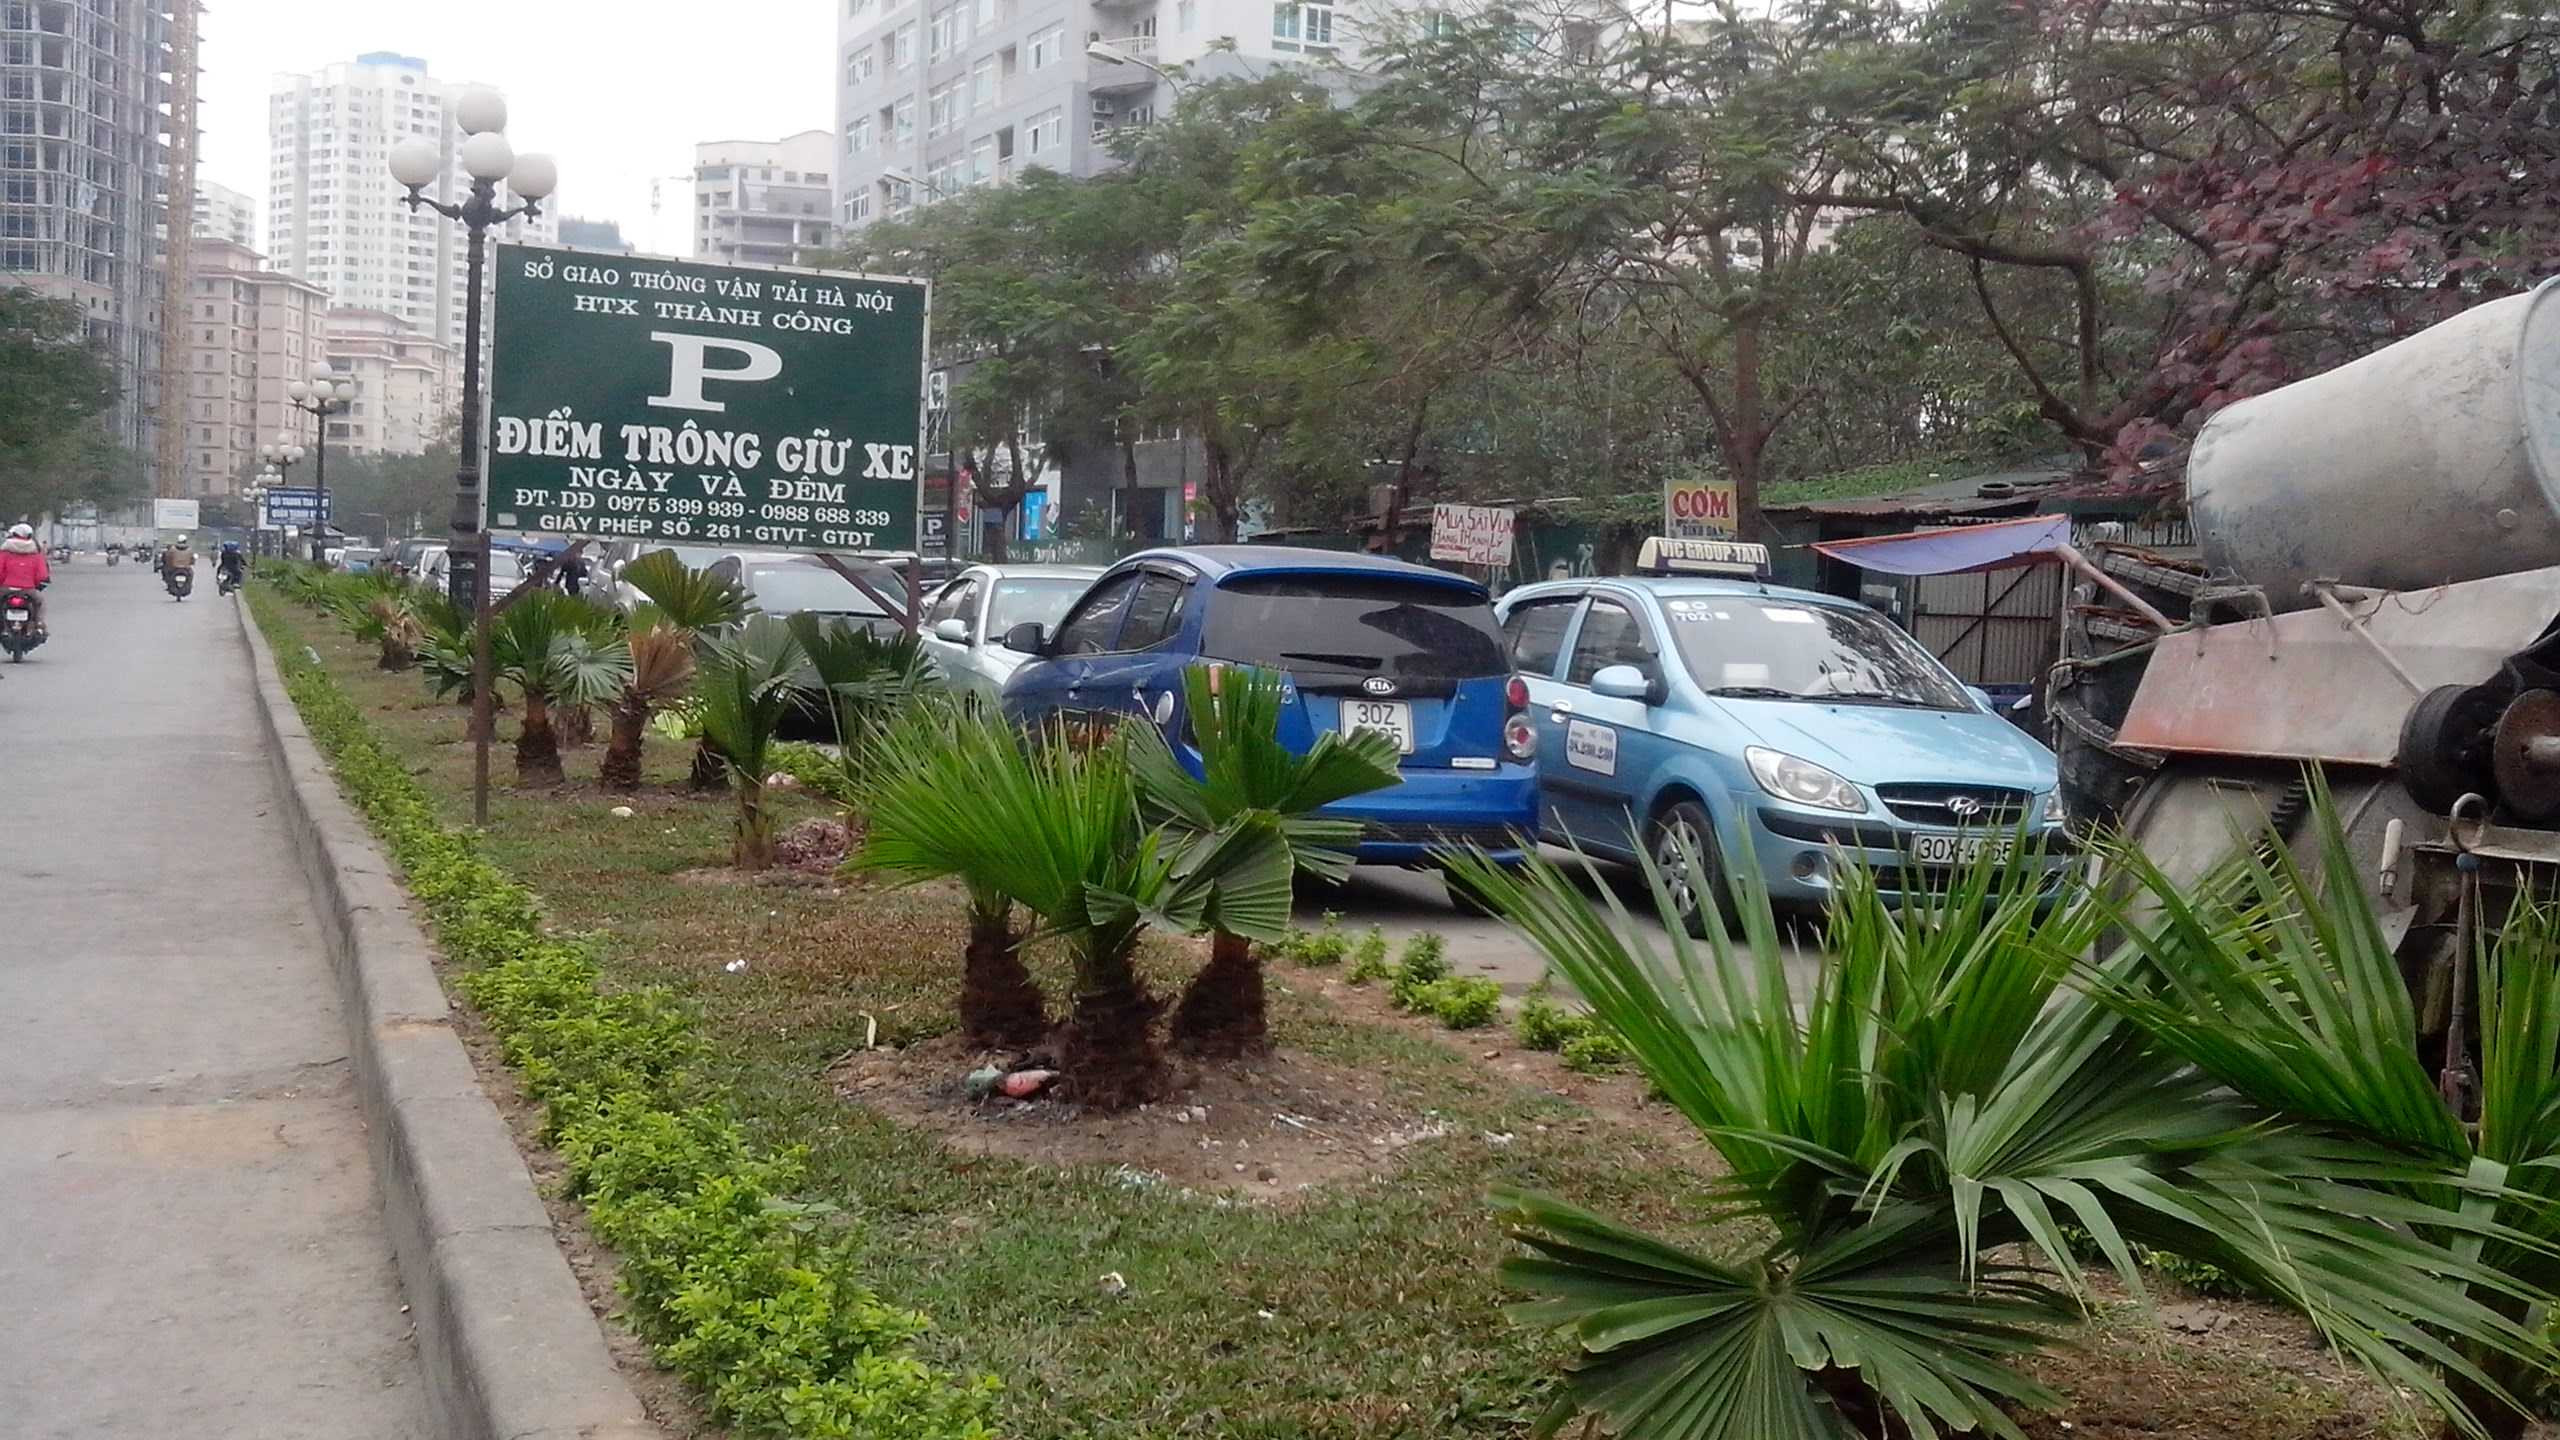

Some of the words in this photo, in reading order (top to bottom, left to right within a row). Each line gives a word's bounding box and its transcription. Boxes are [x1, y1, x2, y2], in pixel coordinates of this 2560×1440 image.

[524, 255, 554, 279] SỞ
[563, 265, 620, 285] GIAO
[630, 270, 706, 293] THÔNG
[715, 276, 761, 300] VẬN
[772, 279, 808, 303] TẢI
[816, 286, 846, 307] HÀ
[856, 290, 894, 314] NỘI
[574, 295, 640, 315] HTX
[654, 301, 762, 327] THÀNH
[772, 310, 854, 335] CÔNG
[647, 330, 783, 413] P
[496, 406, 602, 459] ĐIỂM
[620, 418, 762, 470] TRÔNG
[776, 428, 853, 476] GIỮ
[862, 443, 914, 481] XE
[569, 464, 674, 492] NGÀY
[698, 470, 746, 497] VÀ
[769, 476, 846, 503] ĐÊM
[539, 511, 593, 532] GIẤY
[600, 514, 653, 535] PHÉP
[706, 523, 741, 539] 261
[607, 495, 661, 514] 0975
[665, 499, 703, 516] 399
[708, 501, 745, 518] 939
[760, 504, 810, 522] 0988
[814, 507, 850, 524] 688
[855, 509, 890, 527] 339
[928, 519, 942, 535] P
[1658, 540, 1685, 559] VIC
[1685, 541, 1732, 561] GROUP
[1732, 545, 1766, 564] TAXI
[1368, 680, 1390, 691] KIA
[1357, 704, 1396, 726] 30Z
